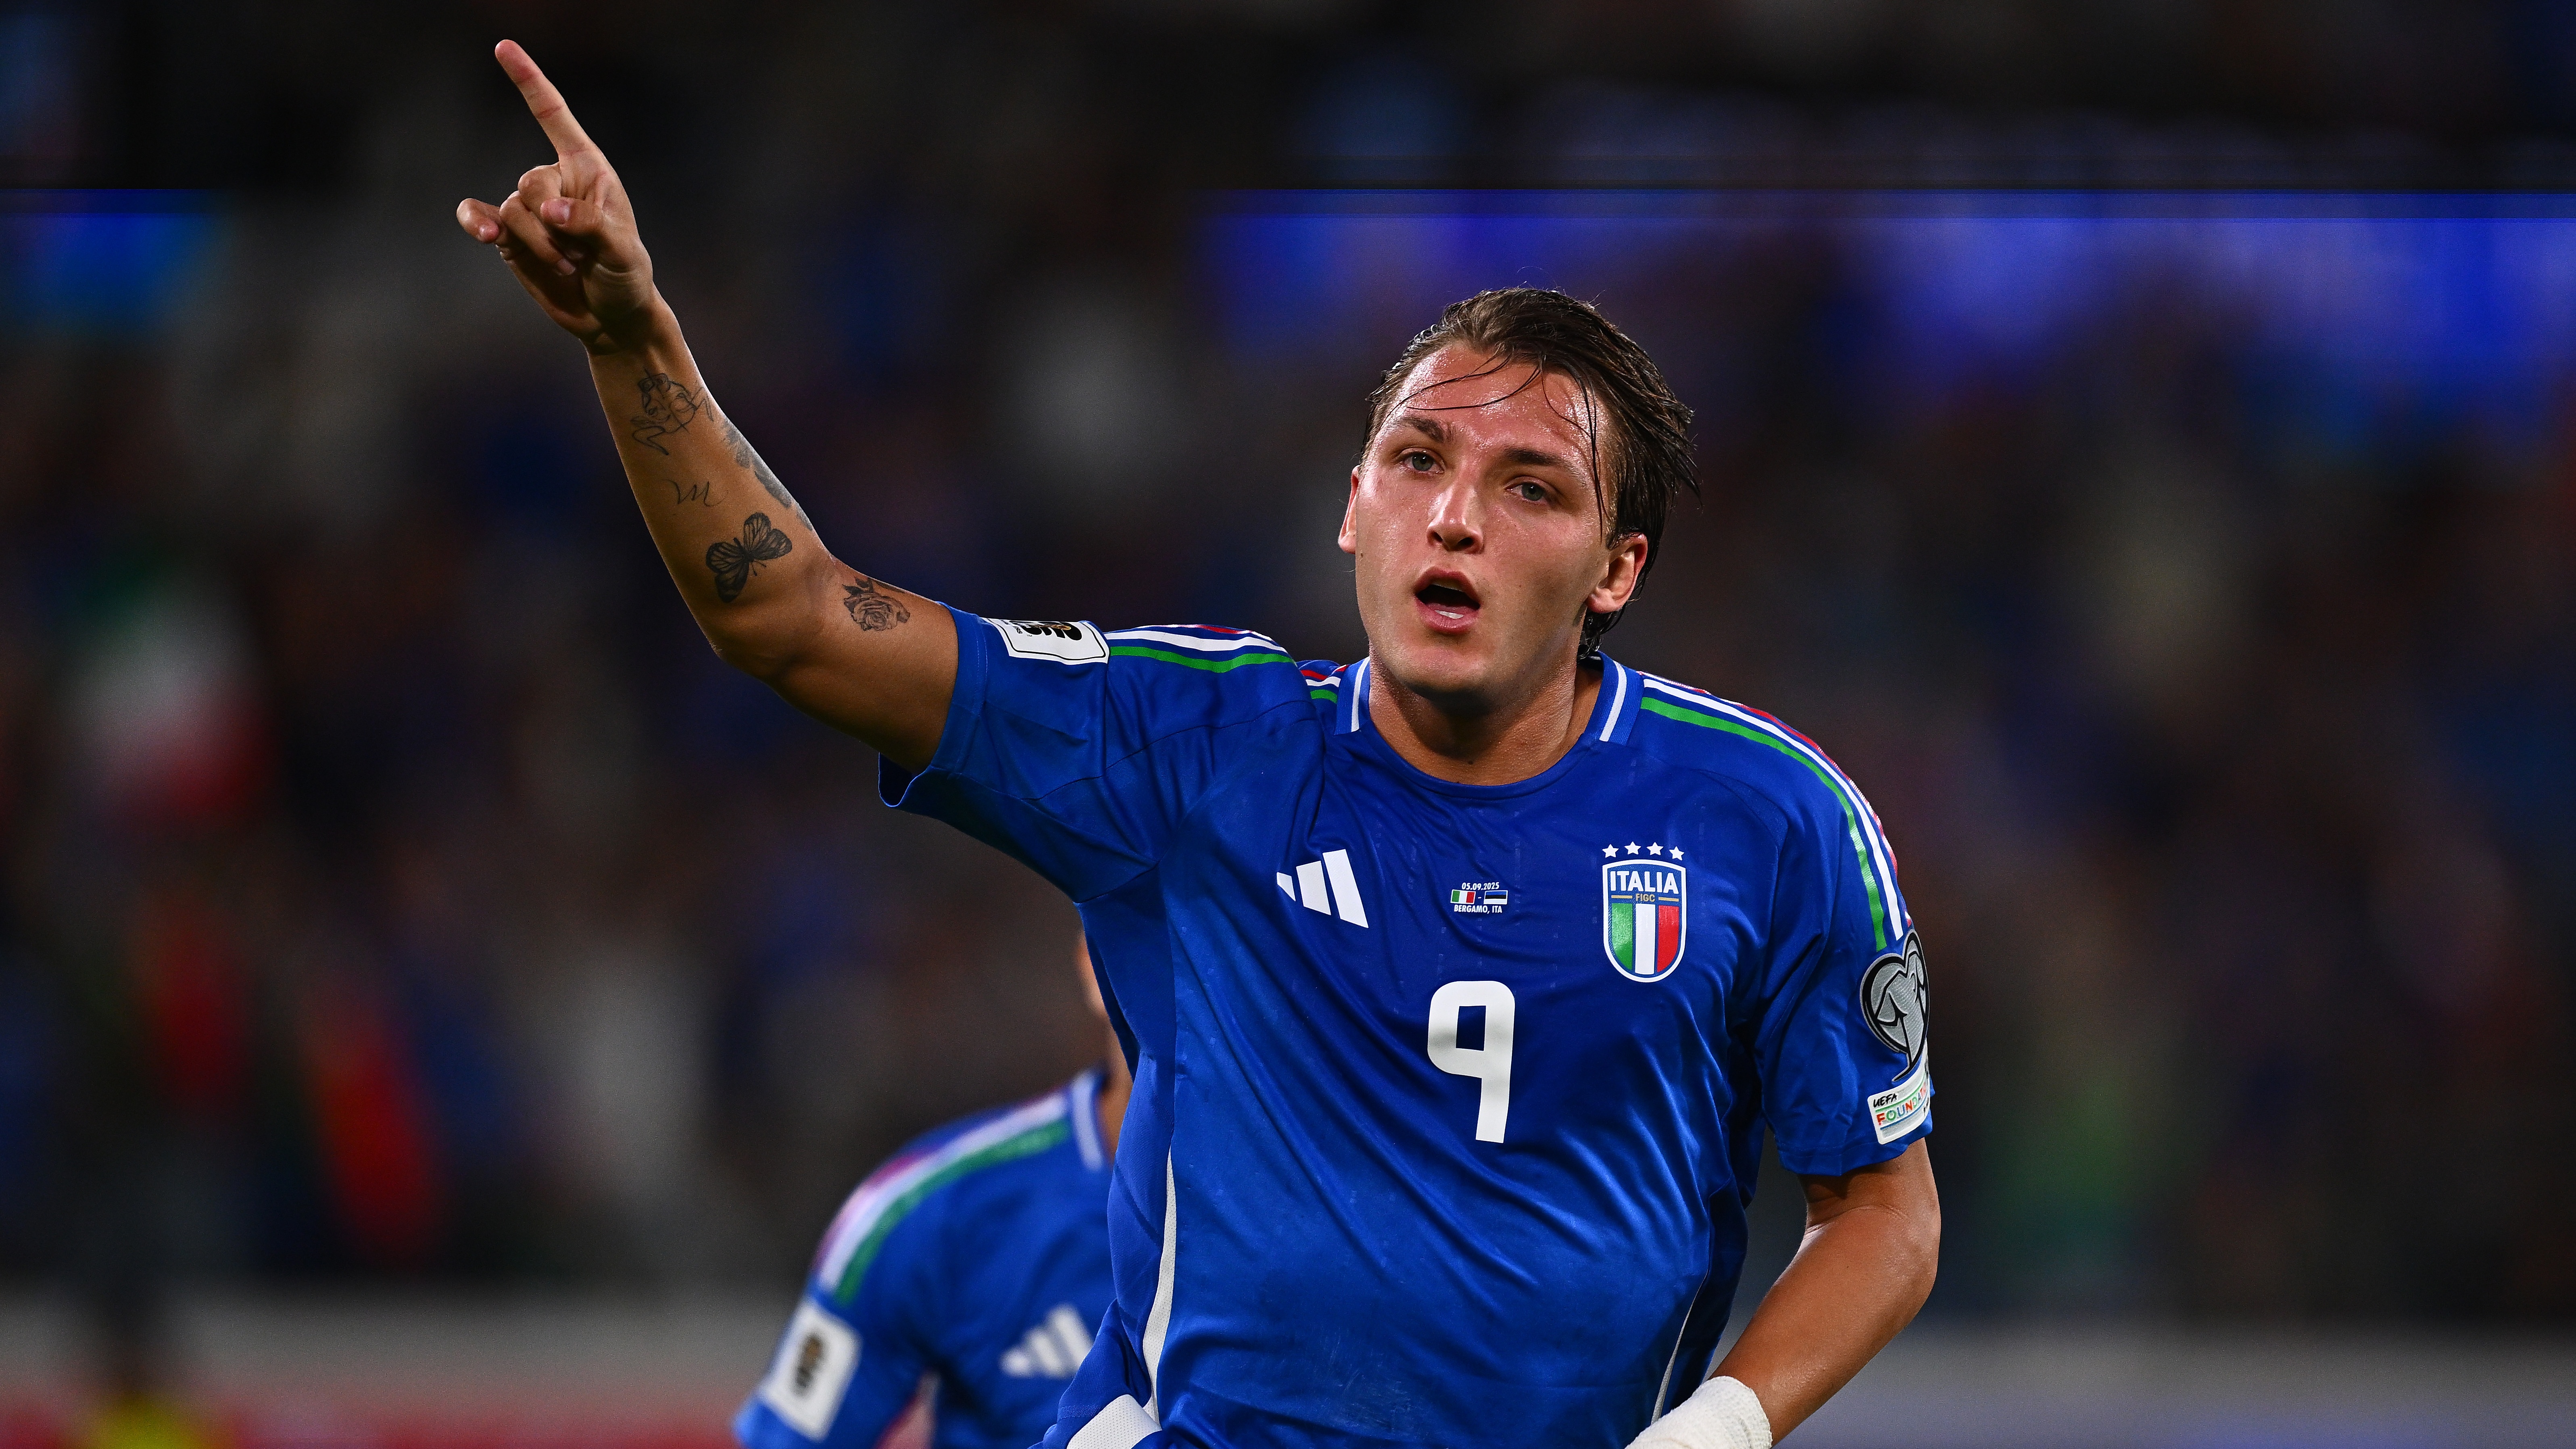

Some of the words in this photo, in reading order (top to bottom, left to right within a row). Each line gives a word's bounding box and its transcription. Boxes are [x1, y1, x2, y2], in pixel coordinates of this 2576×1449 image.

[1462, 882, 1500, 890] 05.09.2025
[1610, 871, 1679, 894] ITALIA
[1635, 893, 1656, 902] FIGC
[1454, 904, 1490, 914] BERGAMO,
[1492, 905, 1502, 913] ITA
[1427, 980, 1515, 1143] 9
[1873, 1093, 1898, 1108] UEFA
